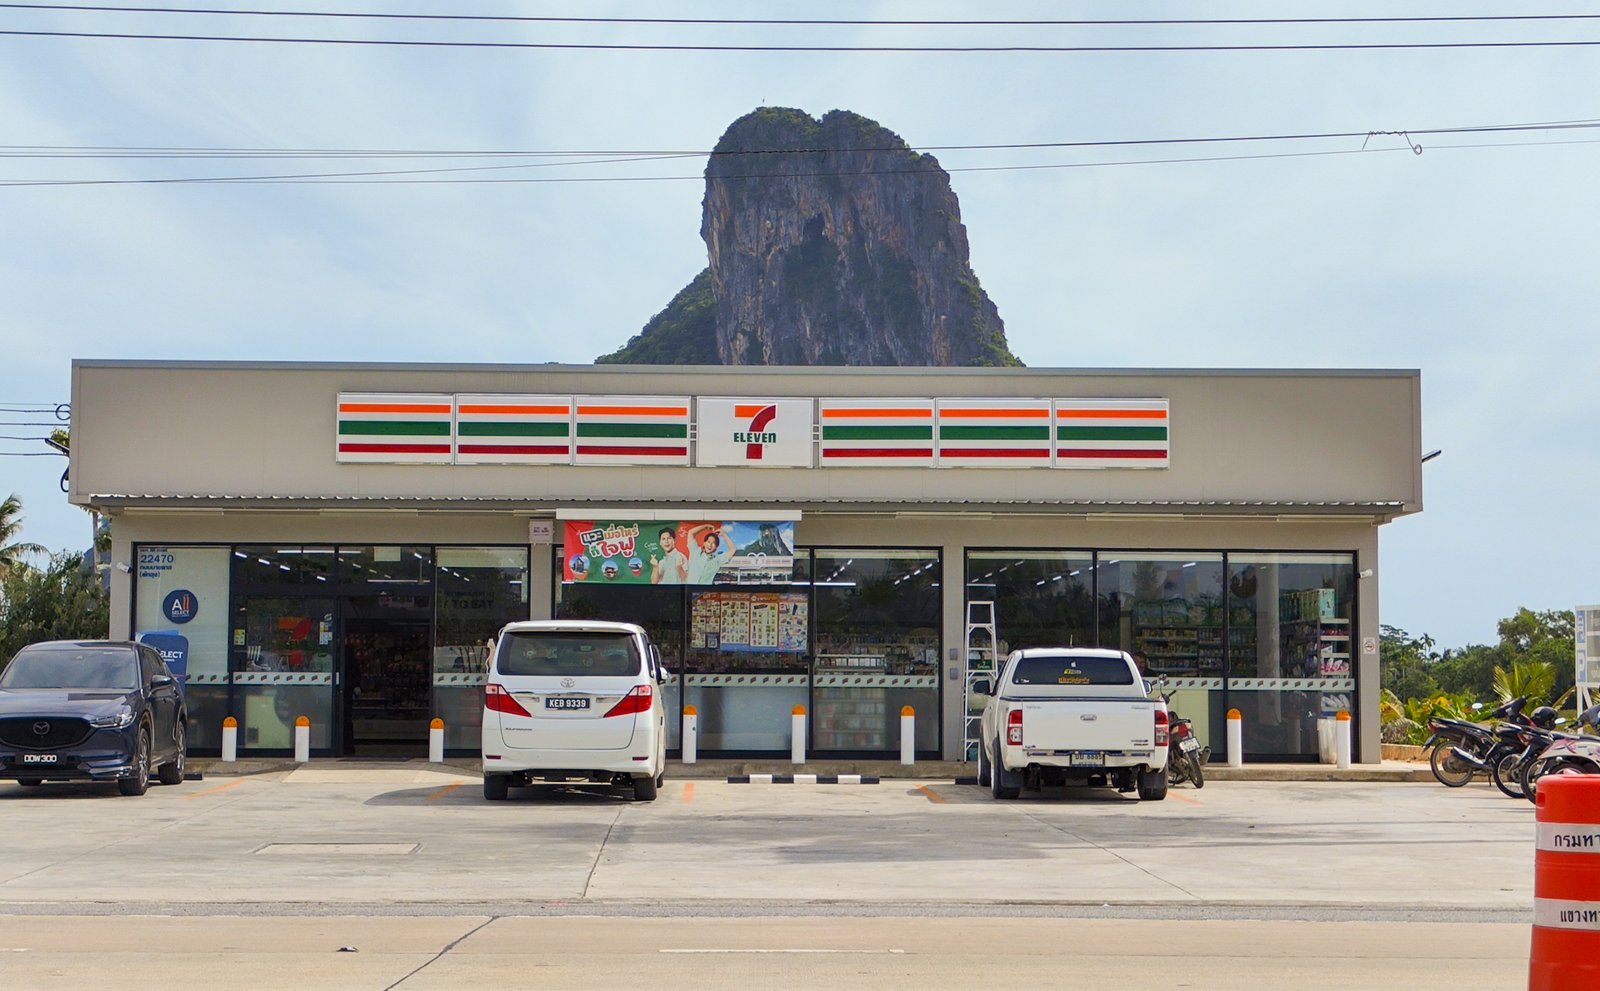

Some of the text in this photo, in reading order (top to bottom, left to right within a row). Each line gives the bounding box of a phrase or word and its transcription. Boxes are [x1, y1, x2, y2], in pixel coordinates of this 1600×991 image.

[735, 405, 776, 459] 7
[140, 554, 174, 563] 22470
[549, 699, 586, 708] KEB 9339
[41, 754, 57, 763] 300
